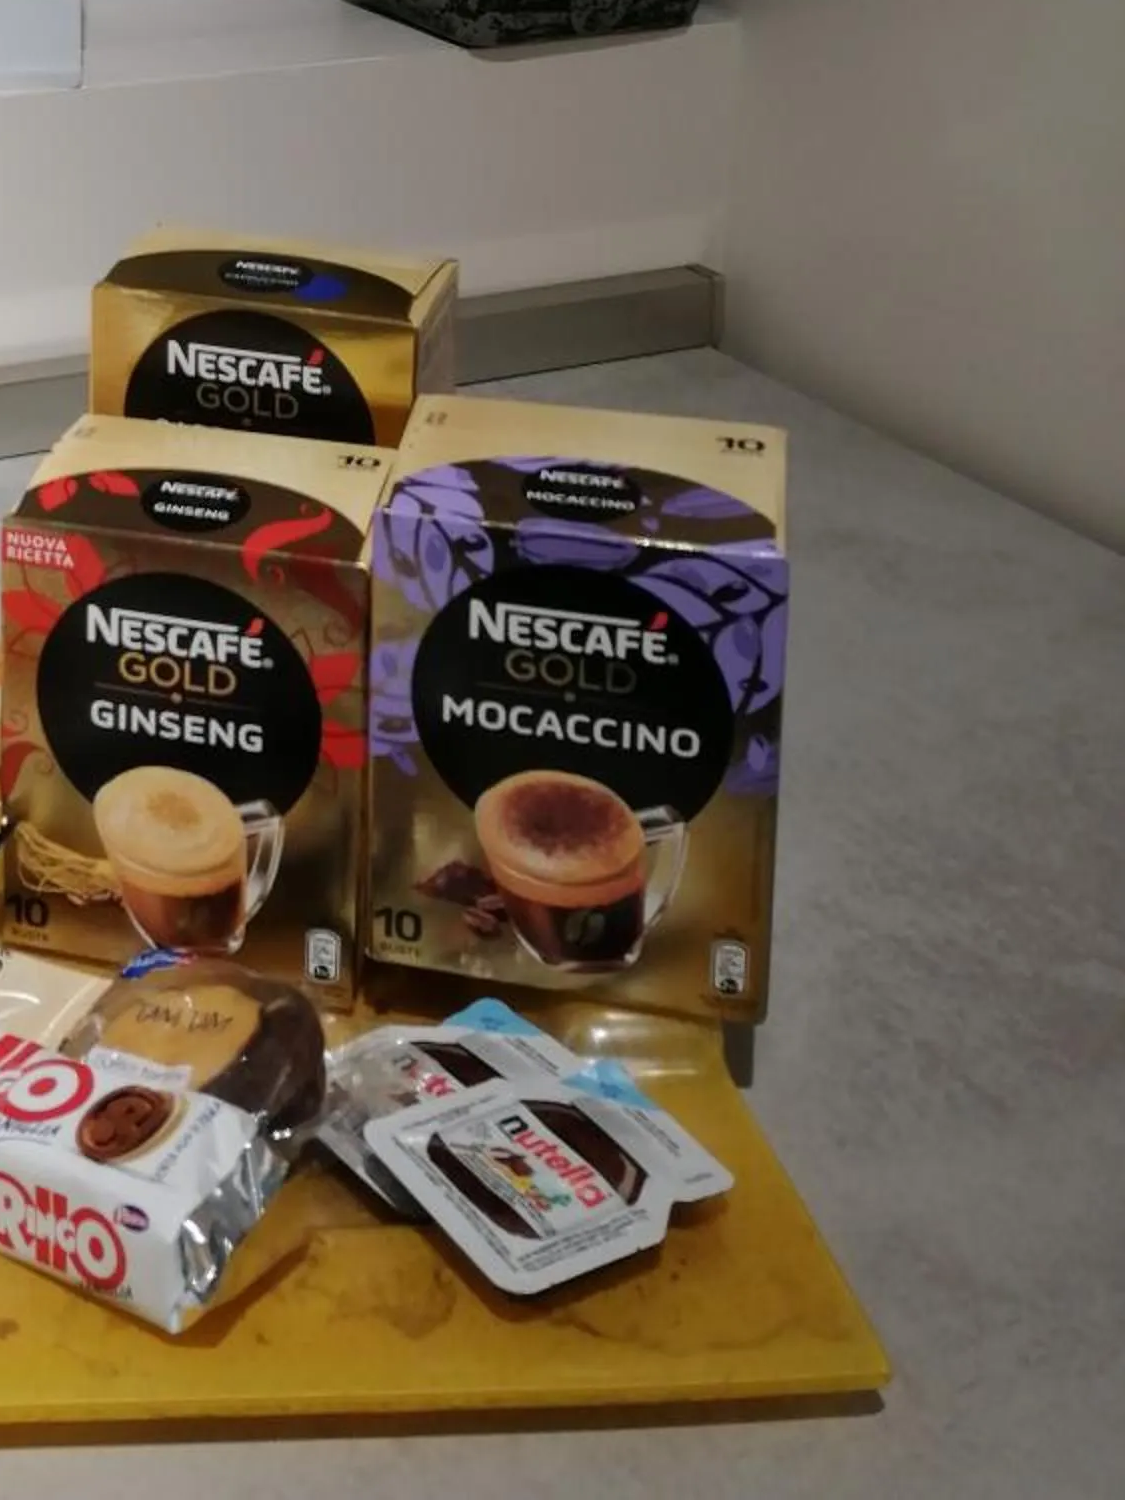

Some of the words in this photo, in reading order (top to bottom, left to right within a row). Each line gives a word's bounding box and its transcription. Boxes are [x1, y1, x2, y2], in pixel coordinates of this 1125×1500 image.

[167, 339, 324, 395] NESCAFÉ
[196, 382, 299, 420] GOLD
[716, 435, 766, 452] 10
[154, 501, 231, 521] GINSENG
[526, 490, 636, 511] MOCACCINO
[6, 532, 67, 552] NUOVA
[6, 547, 74, 568] RICETTA
[86, 603, 267, 669] NESCAFÉ
[469, 599, 668, 664] NESCAFÉ
[118, 652, 237, 696] GOLD
[504, 650, 637, 694] GOLD
[90, 699, 264, 754] GINSENG
[442, 694, 701, 758] MOCACCINO
[6, 893, 49, 928] 10
[375, 906, 422, 942] 10
[497, 1114, 606, 1210] nutella
